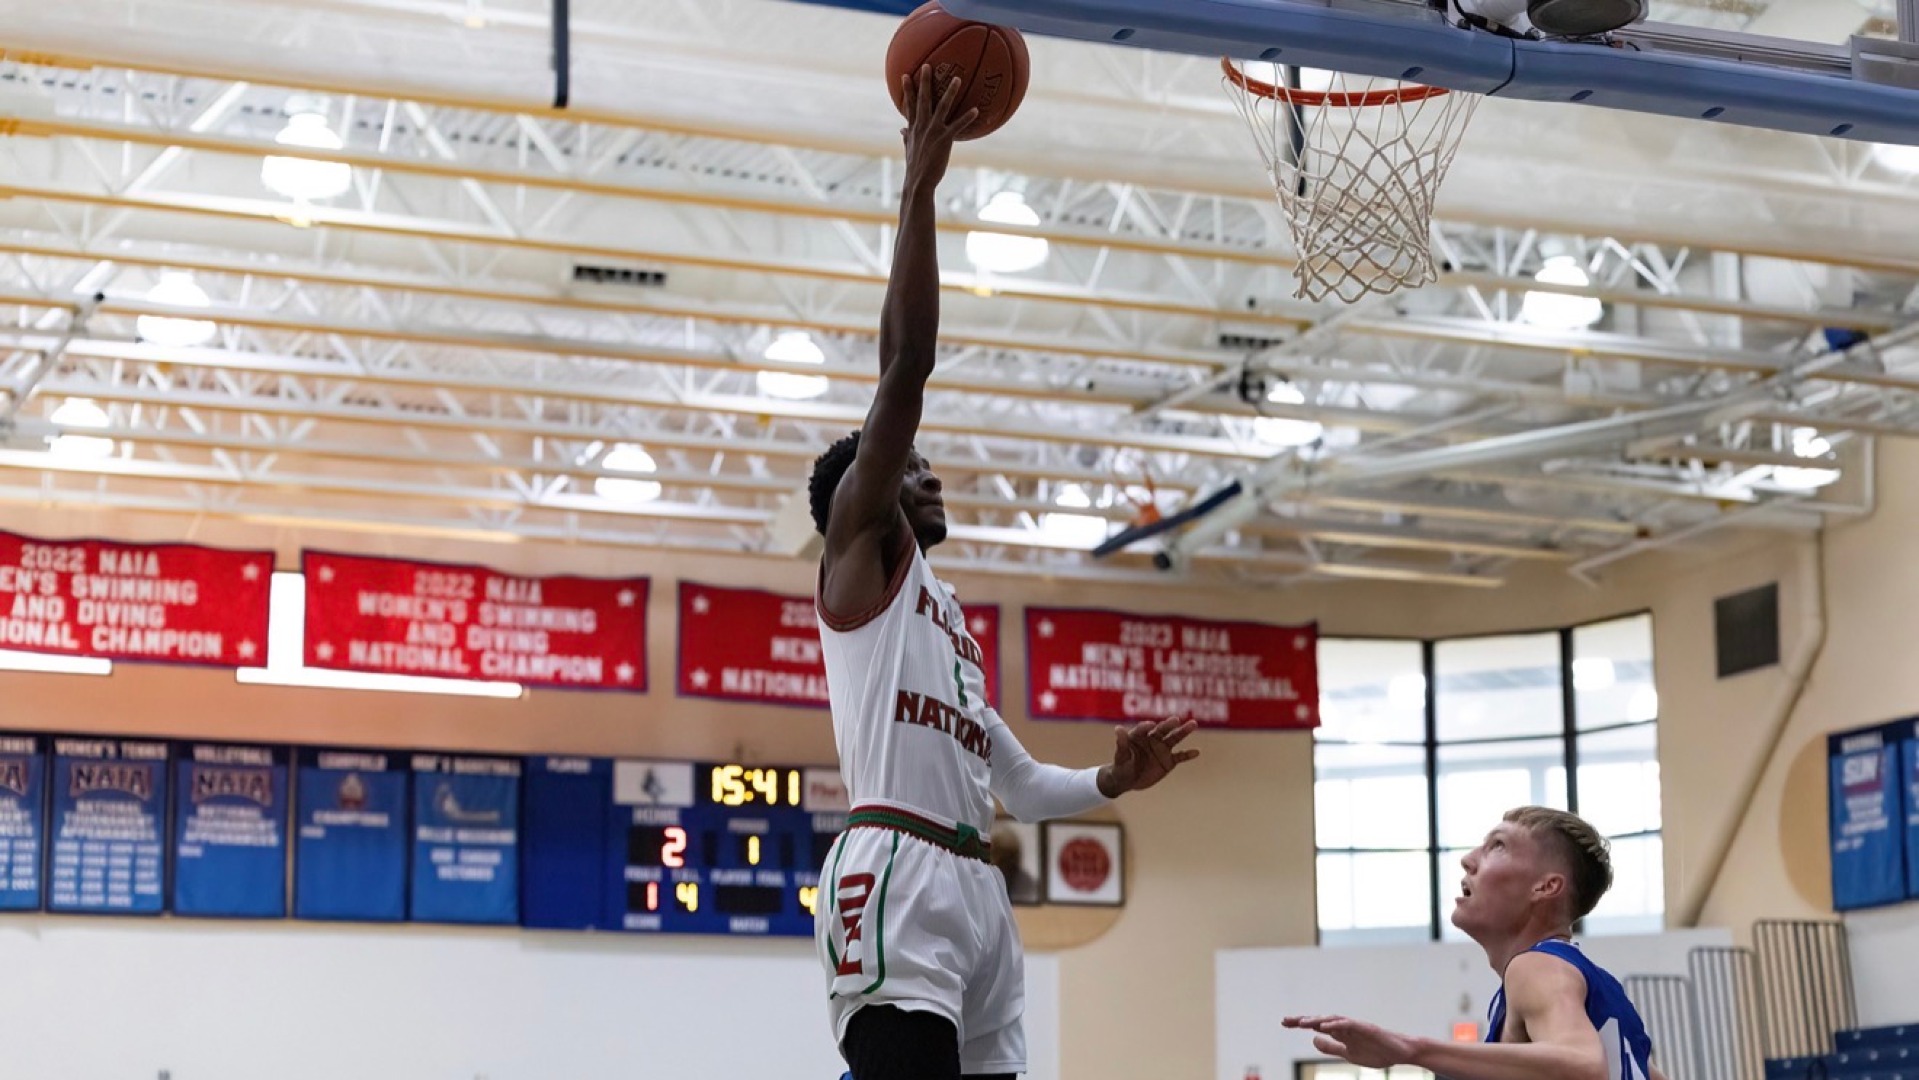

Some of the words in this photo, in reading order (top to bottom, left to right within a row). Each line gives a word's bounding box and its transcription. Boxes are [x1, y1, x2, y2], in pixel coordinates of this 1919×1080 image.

[22, 546, 86, 573] 2022
[100, 551, 160, 576] NAIA
[71, 575, 198, 606] SWIMMING
[415, 572, 475, 599] 2022
[487, 579, 542, 605] NAIA
[12, 596, 66, 622] AND
[78, 601, 165, 628] DIVING
[359, 592, 467, 623] WOMEN'S
[479, 602, 597, 634] SWIMMING
[92, 629, 223, 658] CHAMPION
[407, 622, 456, 647] AND
[467, 626, 549, 655] DIVING
[772, 637, 821, 665] MEN
[1182, 628, 1230, 652] NAIA
[350, 642, 471, 674] NATIONAL
[481, 652, 603, 682] CHAMPION
[1083, 644, 1145, 669] MEN'S
[1051, 665, 1153, 693] NATIONAL
[1162, 675, 1299, 701] INVITATIONAL
[1123, 696, 1230, 722] CHAMPION
[73, 765, 151, 799] NAIA
[194, 770, 272, 807] NAIA
[711, 764, 800, 807] 15:41
[662, 826, 687, 867] 2
[748, 835, 760, 865] 1
[647, 881, 658, 911] 1
[676, 882, 699, 912] 4
